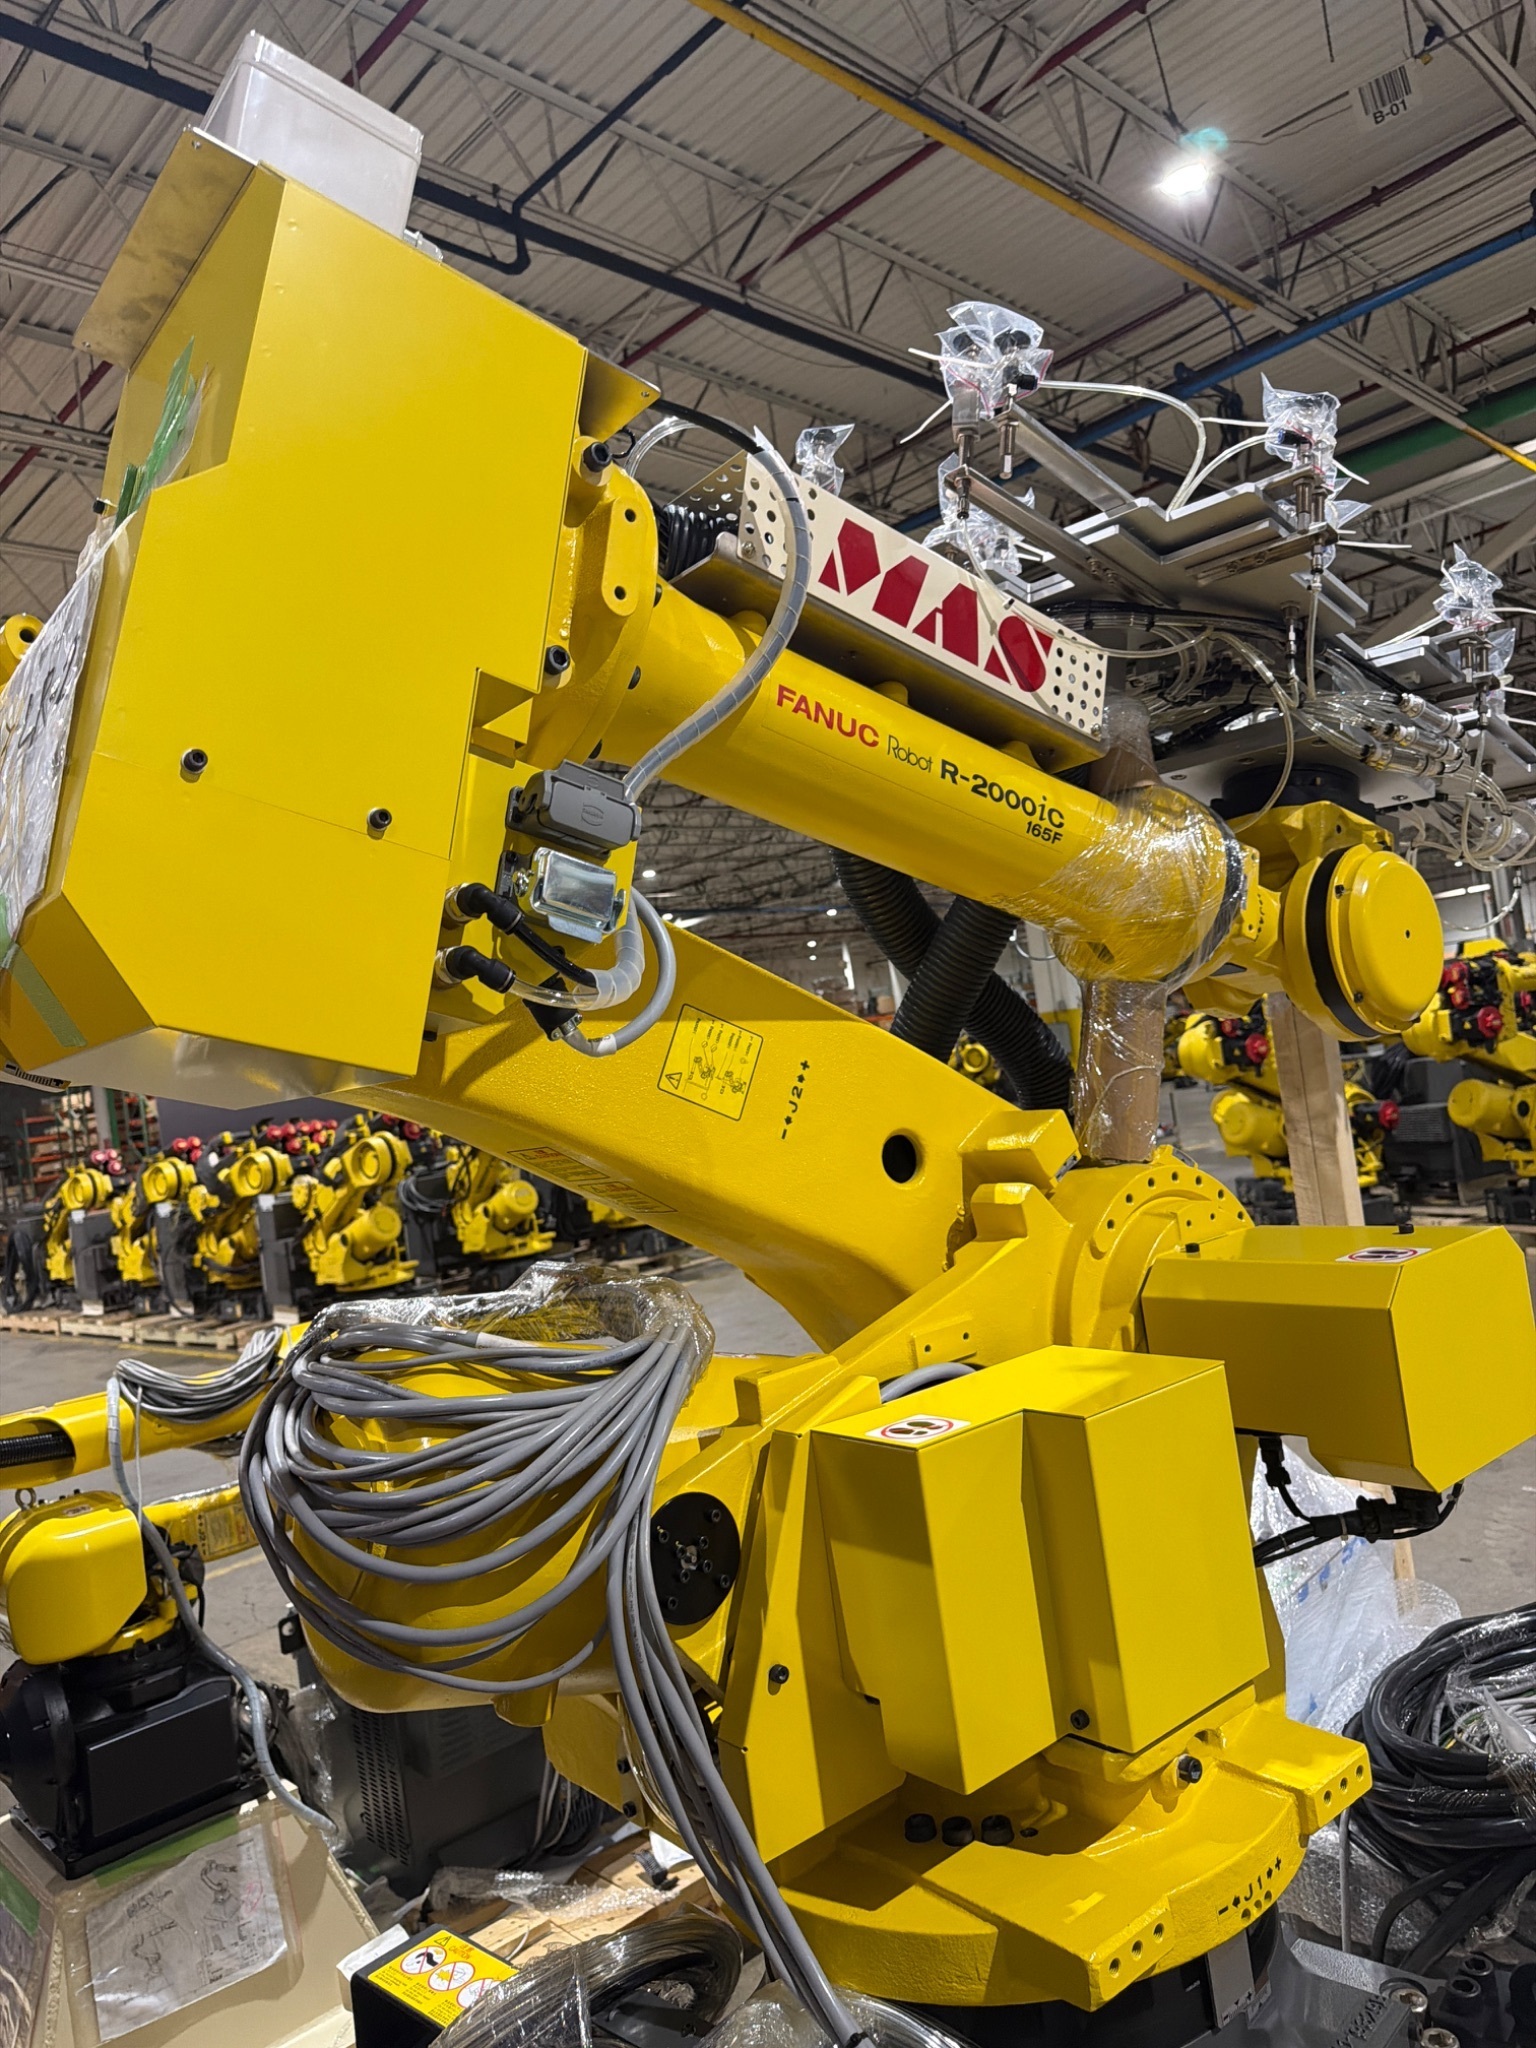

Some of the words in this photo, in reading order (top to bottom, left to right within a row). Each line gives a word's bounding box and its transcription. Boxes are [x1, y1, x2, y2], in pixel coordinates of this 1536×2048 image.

[1373, 98, 1407, 125] B-01
[818, 518, 1053, 692] MAS
[776, 684, 879, 747] FANUC
[887, 734, 933, 773] Robot
[940, 759, 1064, 829] R-2000iC
[1026, 821, 1063, 845] 165F
